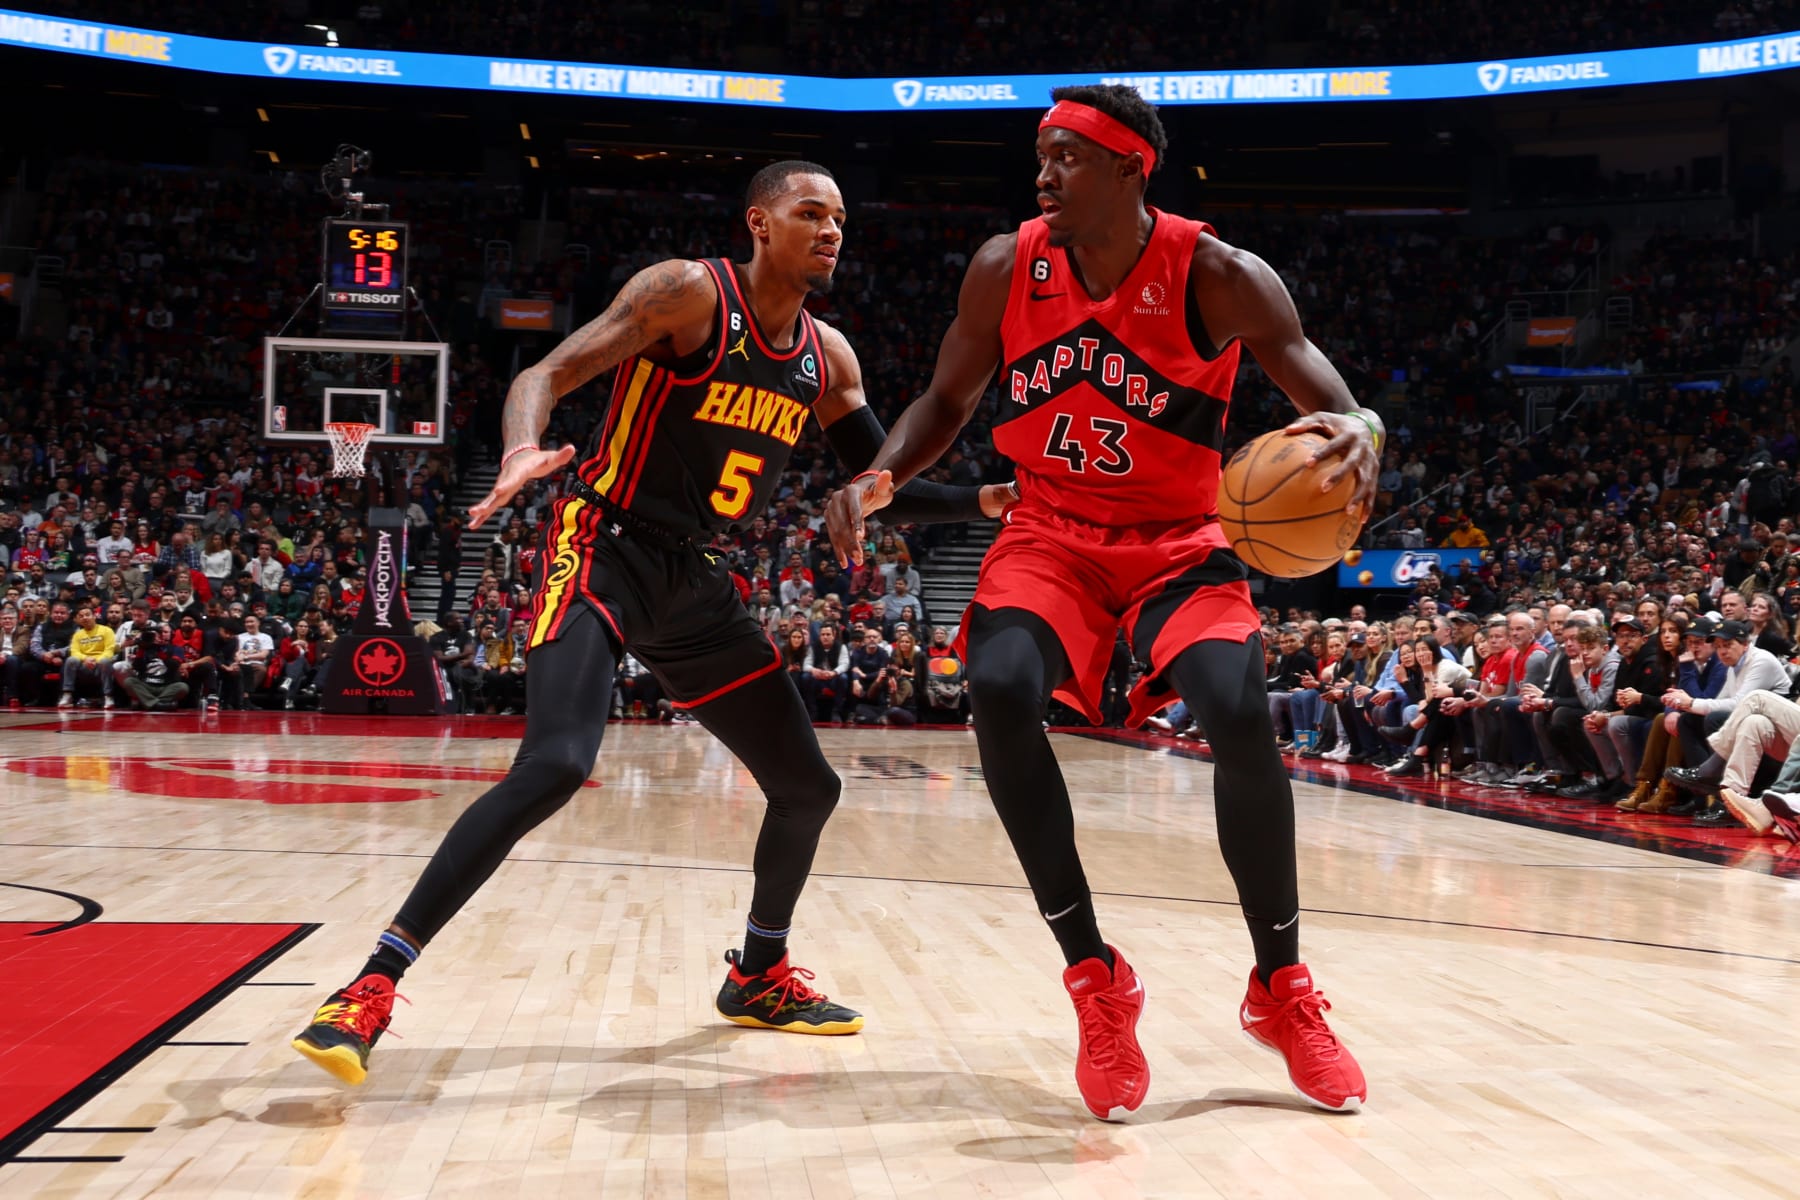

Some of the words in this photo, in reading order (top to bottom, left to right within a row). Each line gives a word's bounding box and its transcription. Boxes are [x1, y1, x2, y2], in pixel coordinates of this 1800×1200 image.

[104, 29, 172, 61] MORE
[1698, 42, 1761, 74] MAKE
[299, 54, 402, 76] FANDUEL
[1510, 61, 1609, 84] FANDUEL
[489, 61, 554, 89] MAKE
[555, 66, 625, 93] EVERY
[626, 70, 721, 98] MOMENT
[724, 76, 785, 102] MORE
[924, 84, 1018, 101] FANDUEL
[1163, 75, 1230, 100] EVERY
[1232, 73, 1326, 98] MOMENT
[1329, 71, 1391, 96] MORE
[348, 228, 399, 251] 5:16
[354, 252, 392, 287] 13
[1034, 260, 1049, 281] 6
[348, 293, 401, 304] TISSOT
[1133, 305, 1152, 315] Sun
[1154, 306, 1171, 316] Life
[730, 312, 742, 331] 6
[1011, 336, 1170, 418] RAPTORS
[692, 380, 811, 447] HAWKS
[1043, 412, 1134, 476] 43
[708, 449, 765, 521] 5
[375, 530, 392, 628] JACKPOTCITY
[342, 688, 363, 697] AIR
[365, 688, 415, 697] CANADA
